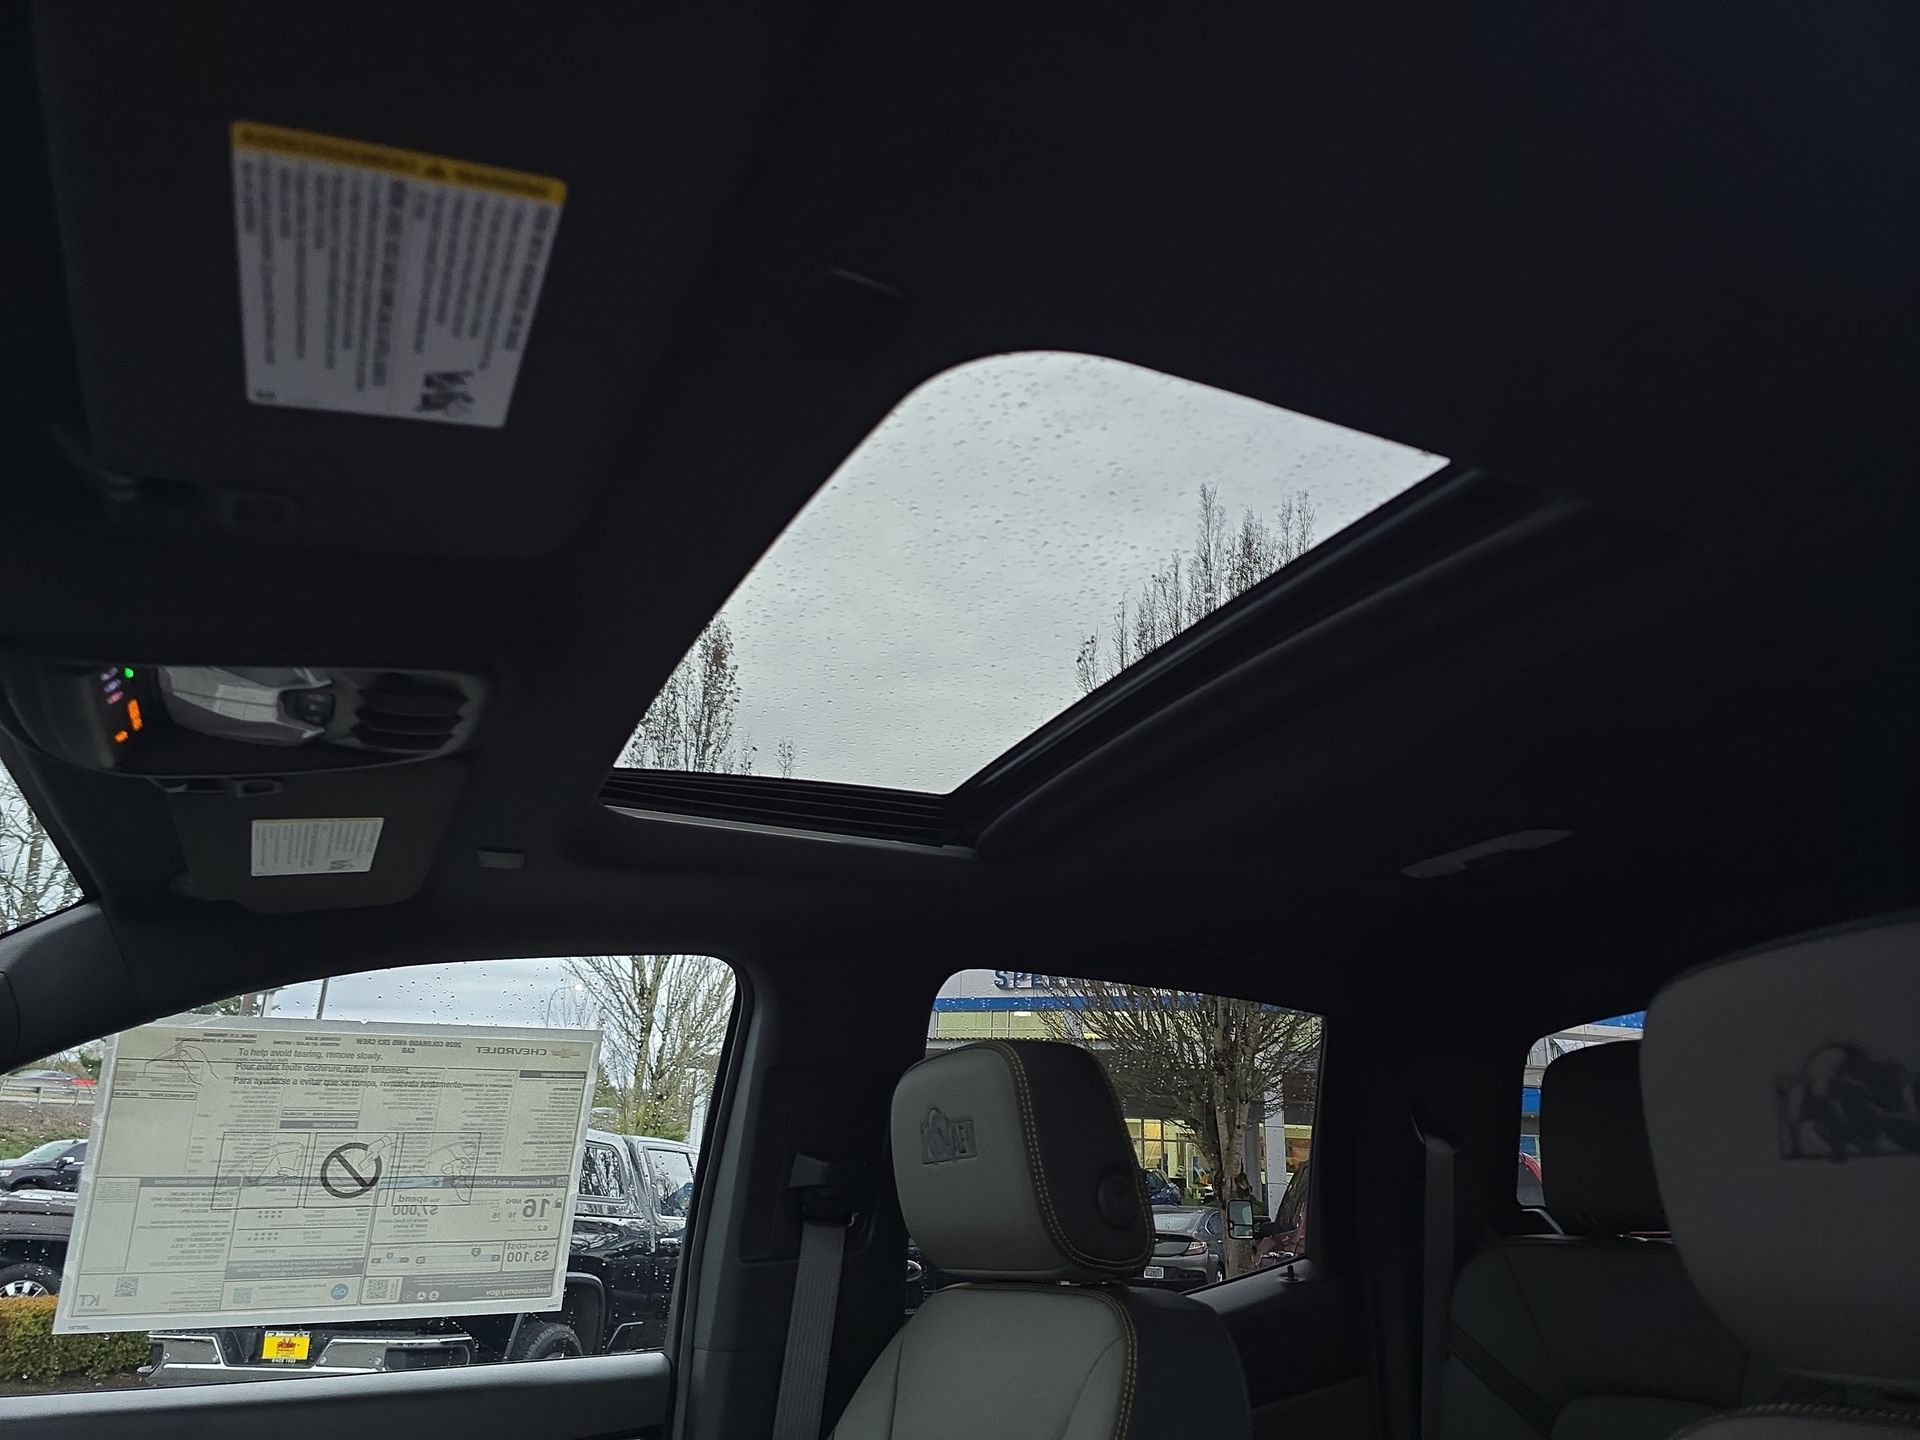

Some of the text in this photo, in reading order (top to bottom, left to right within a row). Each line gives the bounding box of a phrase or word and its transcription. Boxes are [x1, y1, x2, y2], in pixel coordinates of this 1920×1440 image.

[239, 1048, 383, 1062] To help avoid tearing, remove slowly.
[233, 1076, 252, 1084] Para
